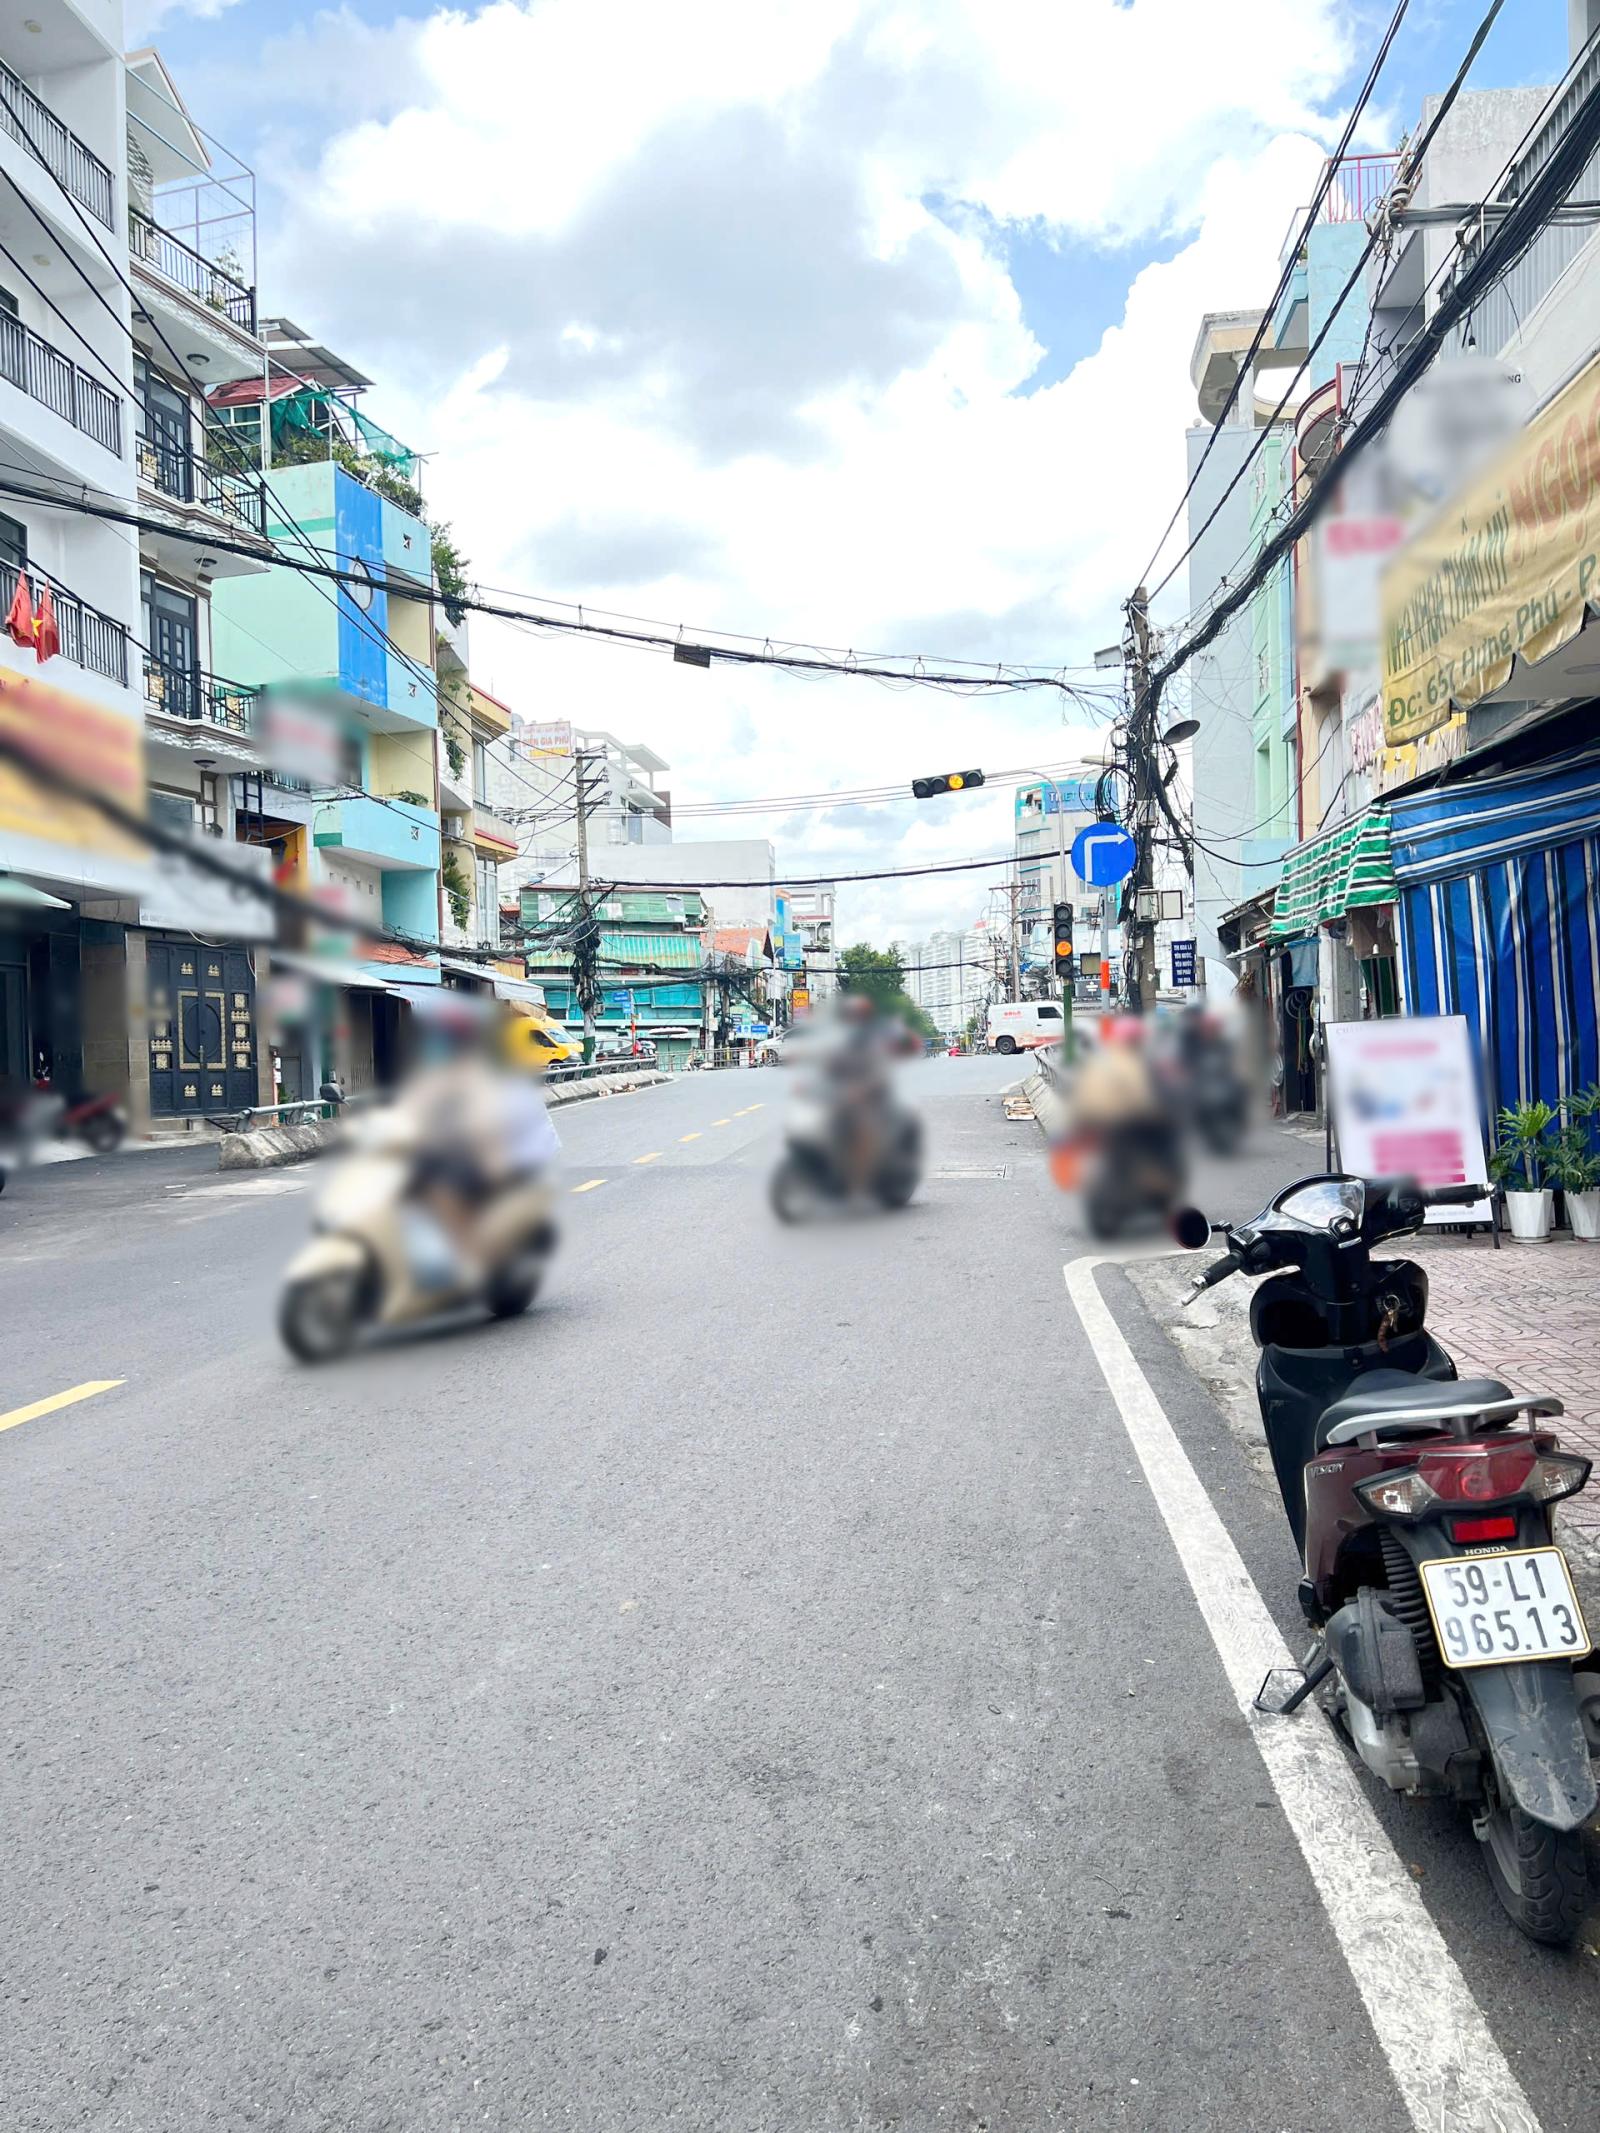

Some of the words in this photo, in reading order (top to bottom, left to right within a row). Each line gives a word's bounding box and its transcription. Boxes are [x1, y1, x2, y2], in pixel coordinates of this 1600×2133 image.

[1464, 1545, 1510, 1556] HONDA
[1444, 1558, 1547, 1608] 59-L1
[1445, 1604, 1578, 1658] 965.13
